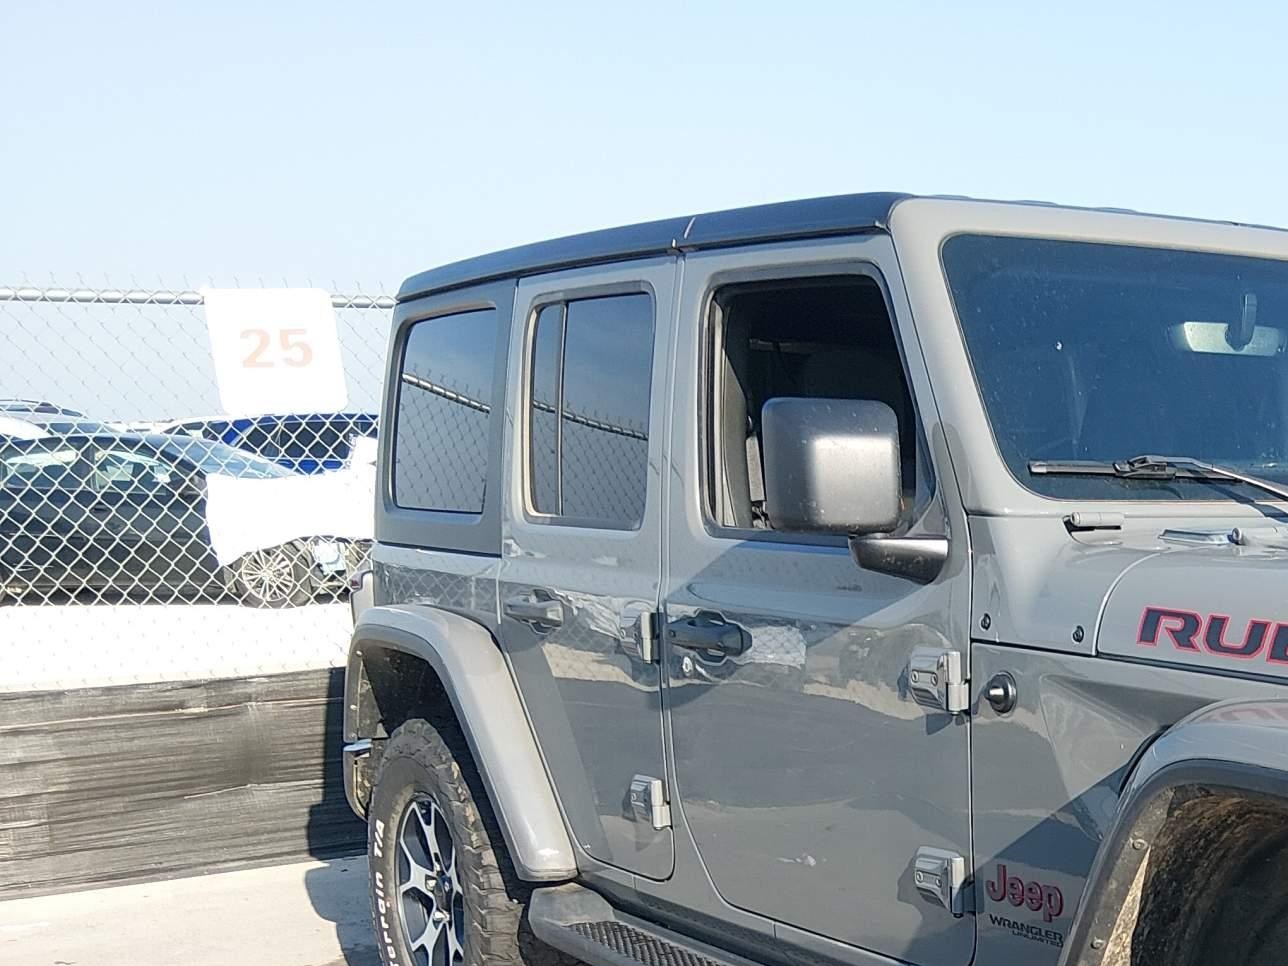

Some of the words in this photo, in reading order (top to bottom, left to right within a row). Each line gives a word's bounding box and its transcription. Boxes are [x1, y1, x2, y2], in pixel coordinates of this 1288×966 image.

[239, 328, 313, 368] 25
[373, 819, 386, 858] T/A
[985, 863, 1064, 923] Jeep
[989, 913, 1064, 941] WRANGLER
